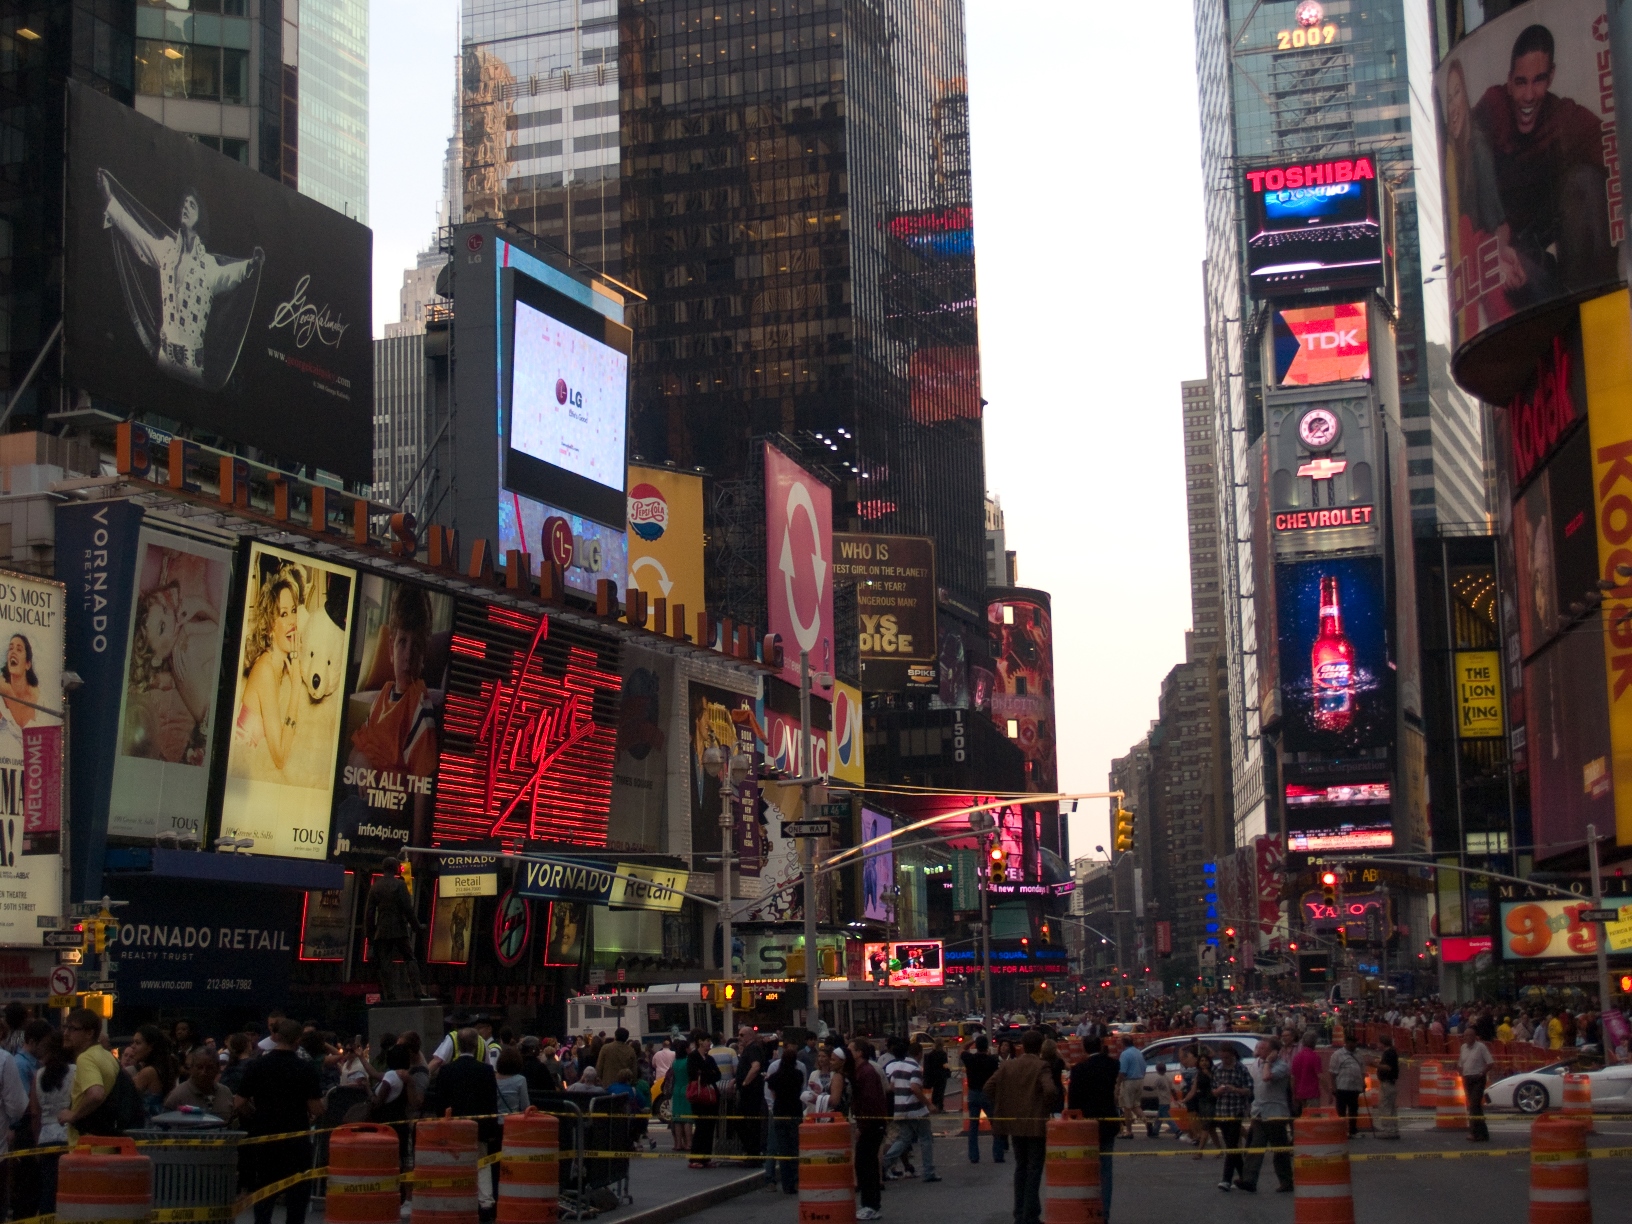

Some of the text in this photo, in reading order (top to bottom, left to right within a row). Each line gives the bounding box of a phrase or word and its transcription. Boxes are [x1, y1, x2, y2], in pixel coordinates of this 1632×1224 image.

[1277, 24, 1336, 50] 2009
[1246, 158, 1374, 193] TOSHIBA
[468, 254, 482, 264] LG
[1301, 328, 1360, 350] TDK
[569, 387, 583, 408] LG
[1275, 506, 1373, 530] CHEVROLET
[573, 535, 602, 573] LG
[841, 542, 889, 560] WHO IS
[832, 564, 928, 578] TEST GIRL ON THE PLANET?
[84, 549, 92, 611] RETAIL
[92, 506, 109, 653] VORNADO
[868, 582, 882, 591] HE
[884, 582, 907, 591] YEAR?
[20, 586, 52, 609] MOST
[858, 597, 917, 607] ANGEROUS MAN?
[597, 578, 784, 667] BUILDING
[860, 614, 898, 636] YS
[859, 633, 913, 653] OICE
[907, 669, 936, 677] SPIKE
[1321, 664, 1349, 673] BUD
[1465, 667, 1490, 679] THE
[1461, 683, 1495, 703] LION
[991, 699, 1039, 710] ONICITY
[1463, 705, 1498, 726] KING
[954, 710, 965, 762] 1500
[27, 734, 42, 830] WELCOME
[343, 765, 433, 795] SICK ALL THE
[615, 774, 632, 787] TIMES
[367, 788, 407, 810] TIME?
[823, 806, 829, 815] W
[830, 806, 839, 815] 46
[171, 816, 199, 831] TOUS
[788, 825, 825, 833] ONE WAY
[293, 827, 325, 845] TOUS
[357, 822, 410, 843] info4pi.org
[439, 855, 496, 866] VORNADO
[454, 875, 481, 886] Retail
[527, 861, 676, 901] VORNADO Retail
[7, 890, 27, 900] THEATRE
[998, 885, 1015, 893] new
[18, 903, 36, 913] STREET
[65, 934, 79, 942] WAY
[121, 924, 290, 951] ORNADO RETAIL
[1505, 903, 1552, 957] 9
[121, 951, 194, 961] REALTY TRUST
[1002, 965, 1017, 973] FOR
[140, 979, 193, 990] www.vno.com
[206, 978, 253, 990] 212-894-7982
[54, 997, 71, 1006] NEW
[171, 1209, 195, 1220] CAUTION
